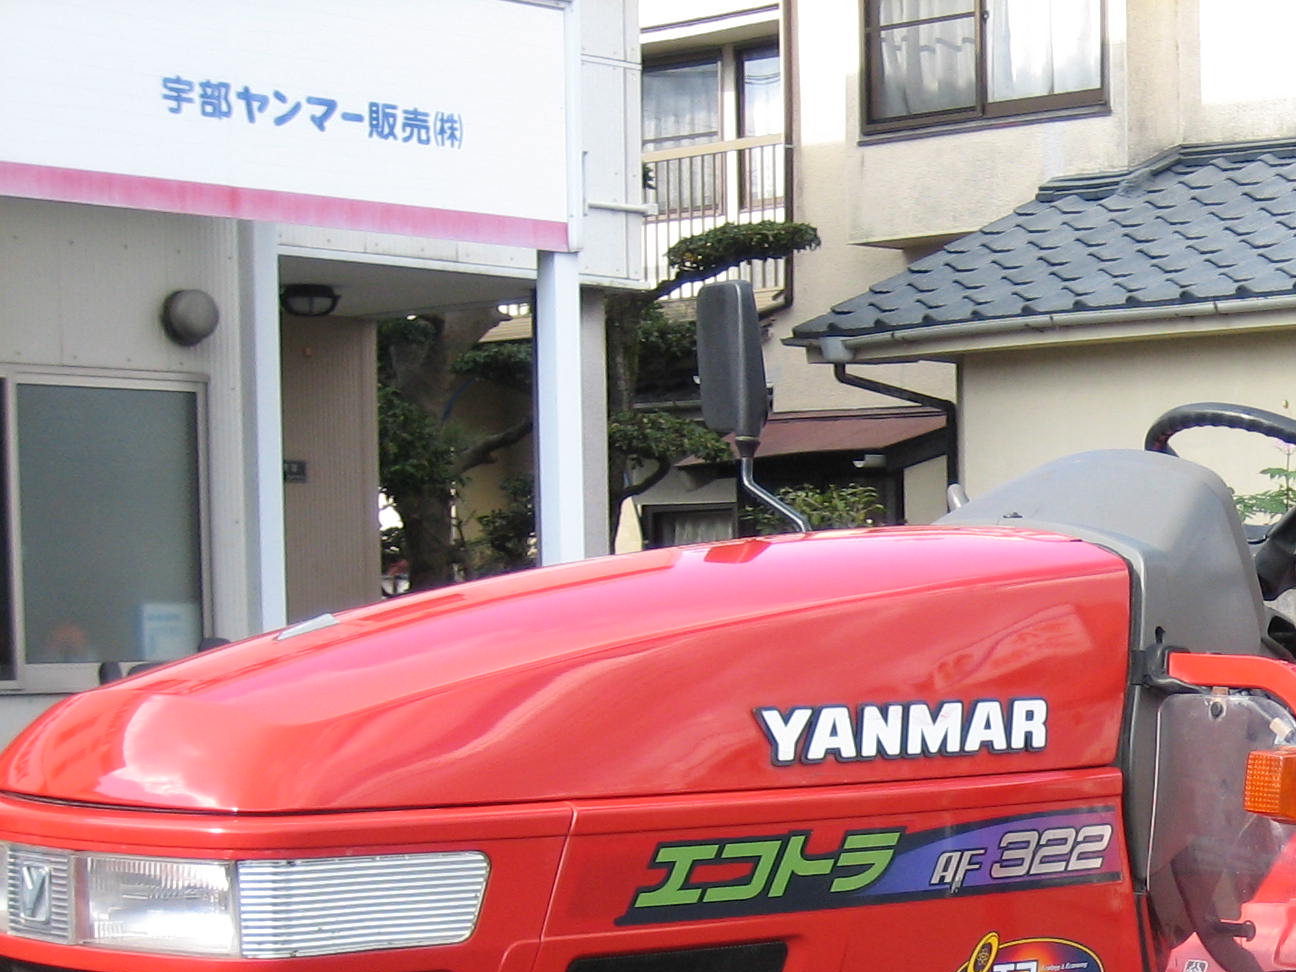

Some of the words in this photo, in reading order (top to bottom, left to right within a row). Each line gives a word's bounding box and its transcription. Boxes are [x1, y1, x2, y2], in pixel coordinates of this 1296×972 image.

[757, 697, 1049, 765] YANMAR
[634, 831, 903, 908] エコトラ
[929, 849, 984, 887] AF
[991, 823, 1113, 879] 322
